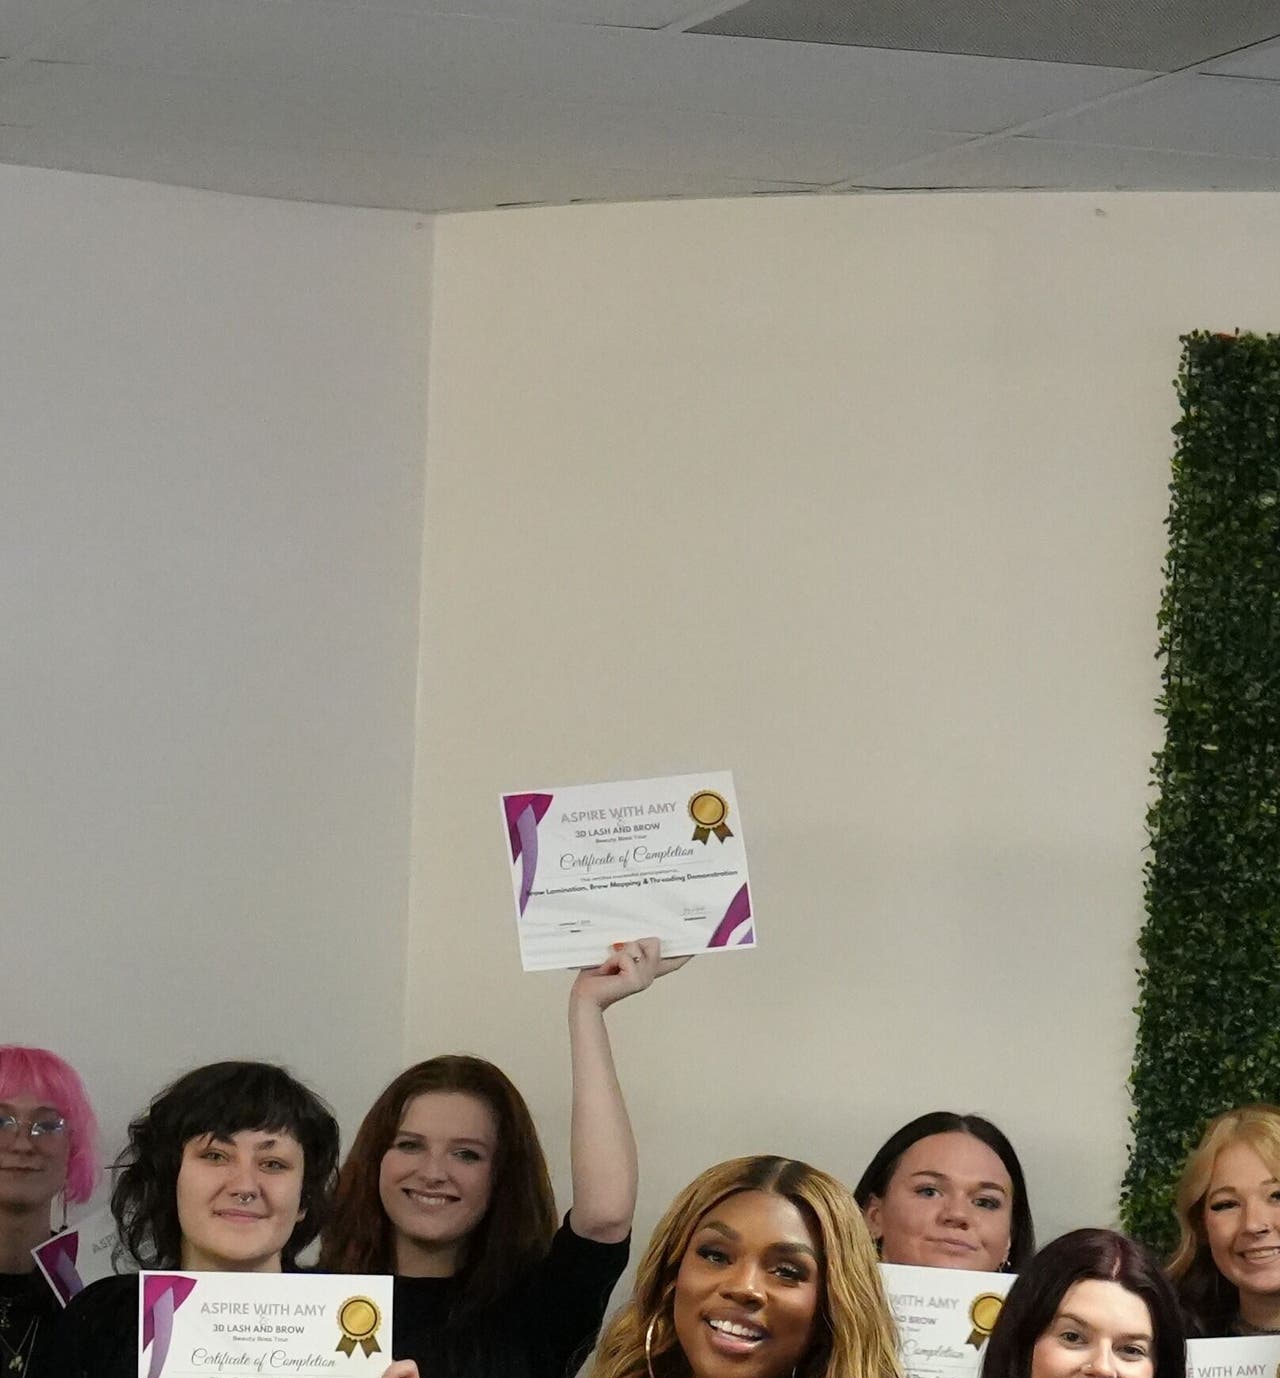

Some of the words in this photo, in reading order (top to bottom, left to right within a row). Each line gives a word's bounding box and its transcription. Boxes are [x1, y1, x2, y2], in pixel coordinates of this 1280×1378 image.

[560, 808, 607, 824] ASPIRE
[609, 804, 644, 819] WITH
[647, 801, 677, 815] AMY
[575, 830, 587, 839] 3D
[588, 827, 611, 837] LASH
[612, 825, 632, 835] AND
[633, 822, 660, 832] BROW
[559, 852, 614, 873] Certificate
[618, 850, 630, 869] of
[632, 845, 694, 864] Completion
[200, 1302, 250, 1315] ASPIRE
[253, 1303, 291, 1316] WITH
[293, 1303, 327, 1317] AMY
[212, 1324, 225, 1333] 3D
[226, 1324, 251, 1333] LASH
[252, 1324, 274, 1334] AND
[275, 1325, 305, 1334] BROW
[190, 1347, 250, 1372] Certificate
[253, 1352, 267, 1373] of
[269, 1349, 336, 1372] Completion
